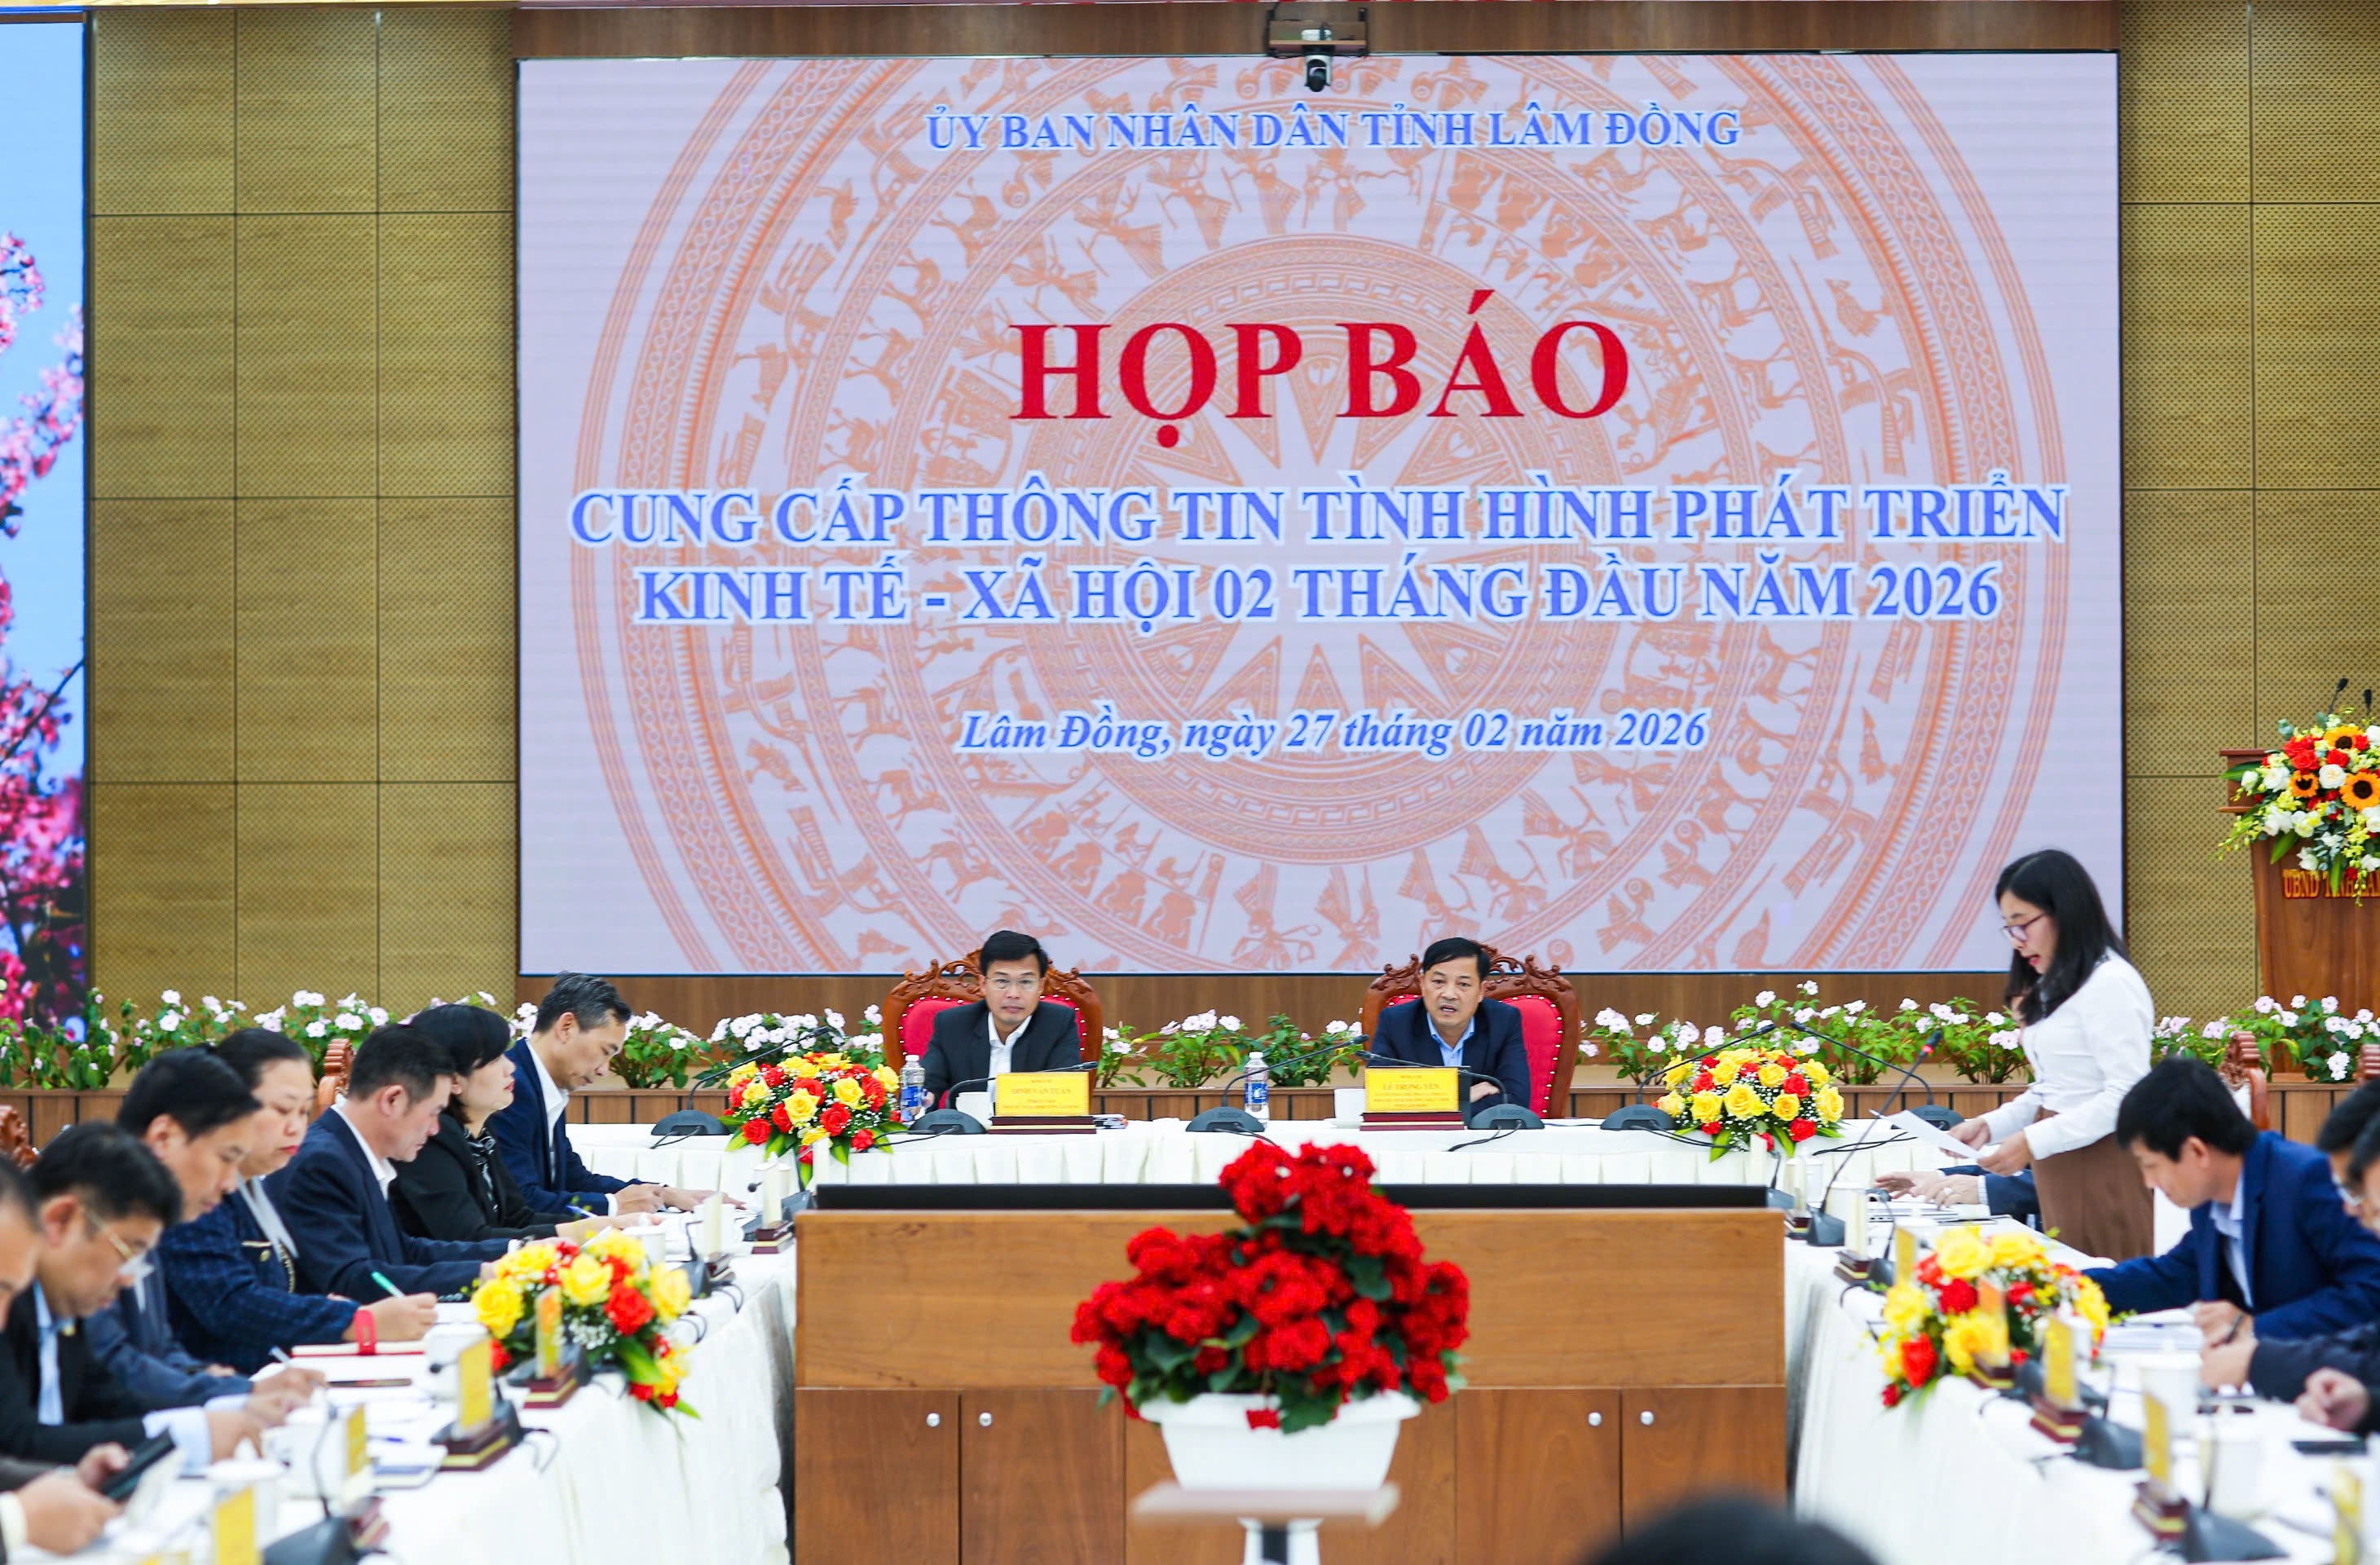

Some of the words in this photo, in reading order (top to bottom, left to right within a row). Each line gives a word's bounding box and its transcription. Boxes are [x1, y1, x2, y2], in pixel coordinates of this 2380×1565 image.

[926, 104, 989, 149] ỦY
[1001, 113, 1095, 148] BAN
[1108, 103, 1238, 148] NHÂN
[1253, 102, 1349, 147] DÂN
[1360, 102, 1474, 147] TỈNH
[1489, 101, 1591, 146] LÂM
[1604, 100, 1740, 146] ĐỒNG
[1010, 322, 1302, 448] HỌP
[1337, 289, 1629, 420] BÁO
[571, 492, 758, 544] CUNG
[775, 475, 906, 544] CẤP
[918, 474, 1157, 543] THÔNG
[1172, 491, 1285, 541] TIN
[1301, 474, 1466, 541] TÌNH
[1481, 474, 1653, 541] HÌNH
[1669, 472, 1848, 540] PHÁT
[1862, 471, 2066, 540] TRIỂN
[638, 571, 809, 620] KINH
[823, 553, 907, 620] TẾ
[961, 555, 1056, 620] XÃ
[1071, 560, 1197, 633] HỘI
[1214, 568, 1275, 619] 02
[1292, 551, 1527, 619] THÁNG
[1544, 550, 1683, 619] ĐẦU
[1699, 552, 1853, 618] NĂM
[1871, 566, 1999, 618] 2026
[959, 714, 1047, 749] Lâm
[1056, 703, 1171, 758] Đồng,
[1183, 712, 1277, 758] ngày
[1285, 713, 1336, 748] 27
[1342, 712, 1454, 757] tháng
[1464, 712, 1510, 747] 02
[1519, 712, 1604, 747] năm
[1614, 712, 1708, 747] 2026
[2282, 869, 2320, 898] UBND
